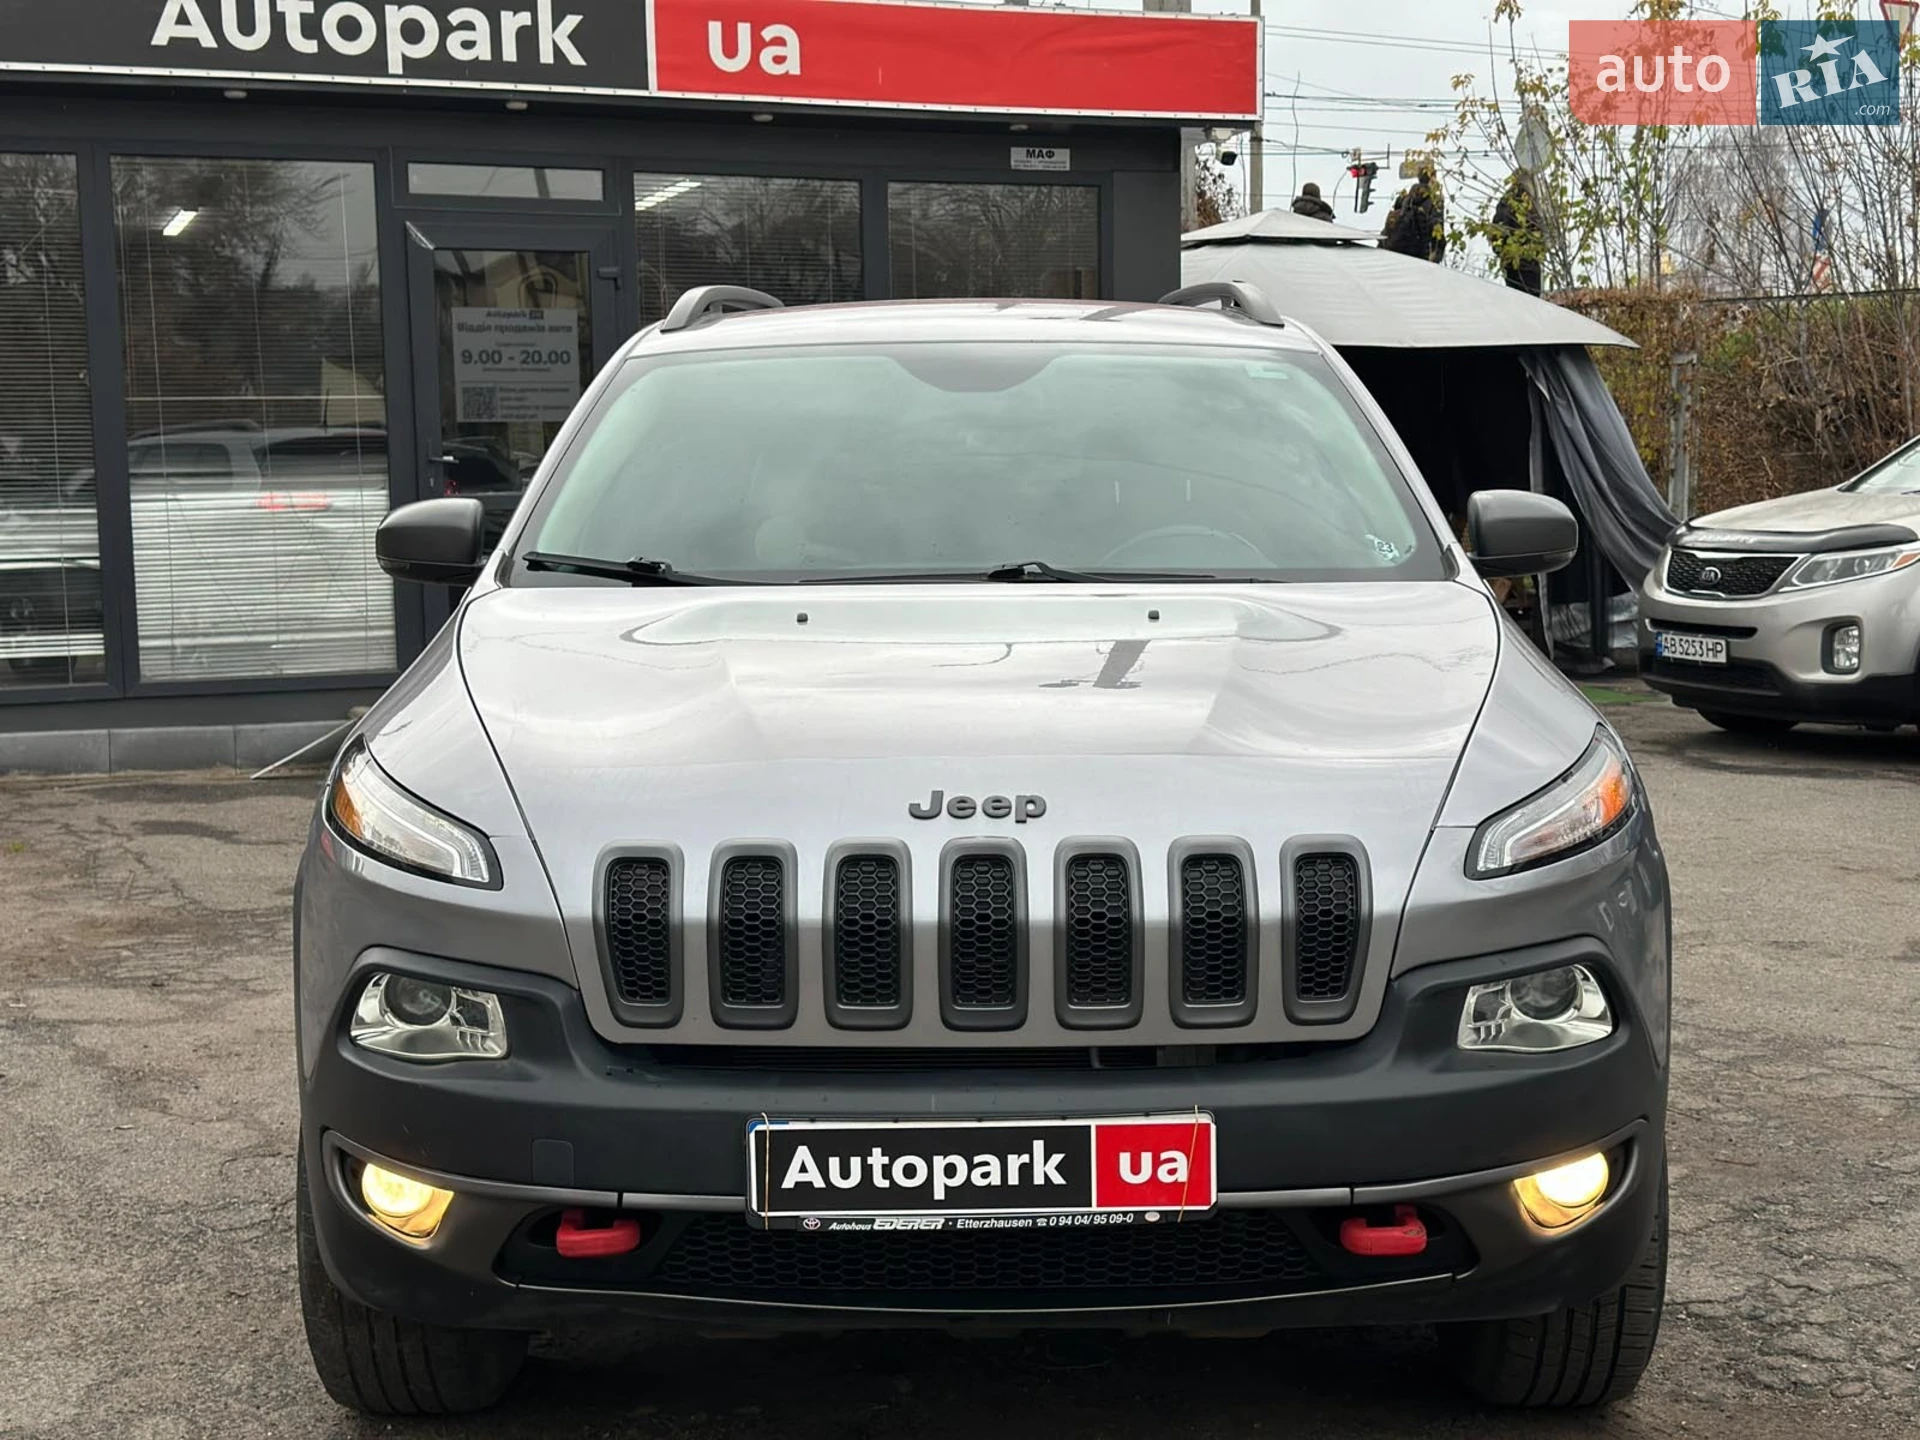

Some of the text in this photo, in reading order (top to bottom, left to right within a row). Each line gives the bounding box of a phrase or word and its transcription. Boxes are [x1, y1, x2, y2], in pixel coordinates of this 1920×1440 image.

[150, 0, 802, 76] Autopark ua
[1026, 148, 1055, 159] МАФ
[461, 350, 503, 365] 9.00
[520, 350, 571, 365] 20.00
[1663, 636, 1724, 658] AB 5253 HP
[908, 790, 1047, 824] Jeep
[780, 1139, 1188, 1200] Autopark ua
[828, 1221, 871, 1231] Autohaus
[872, 1217, 946, 1230] EDERER
[956, 1217, 1032, 1229] Etterzhausen
